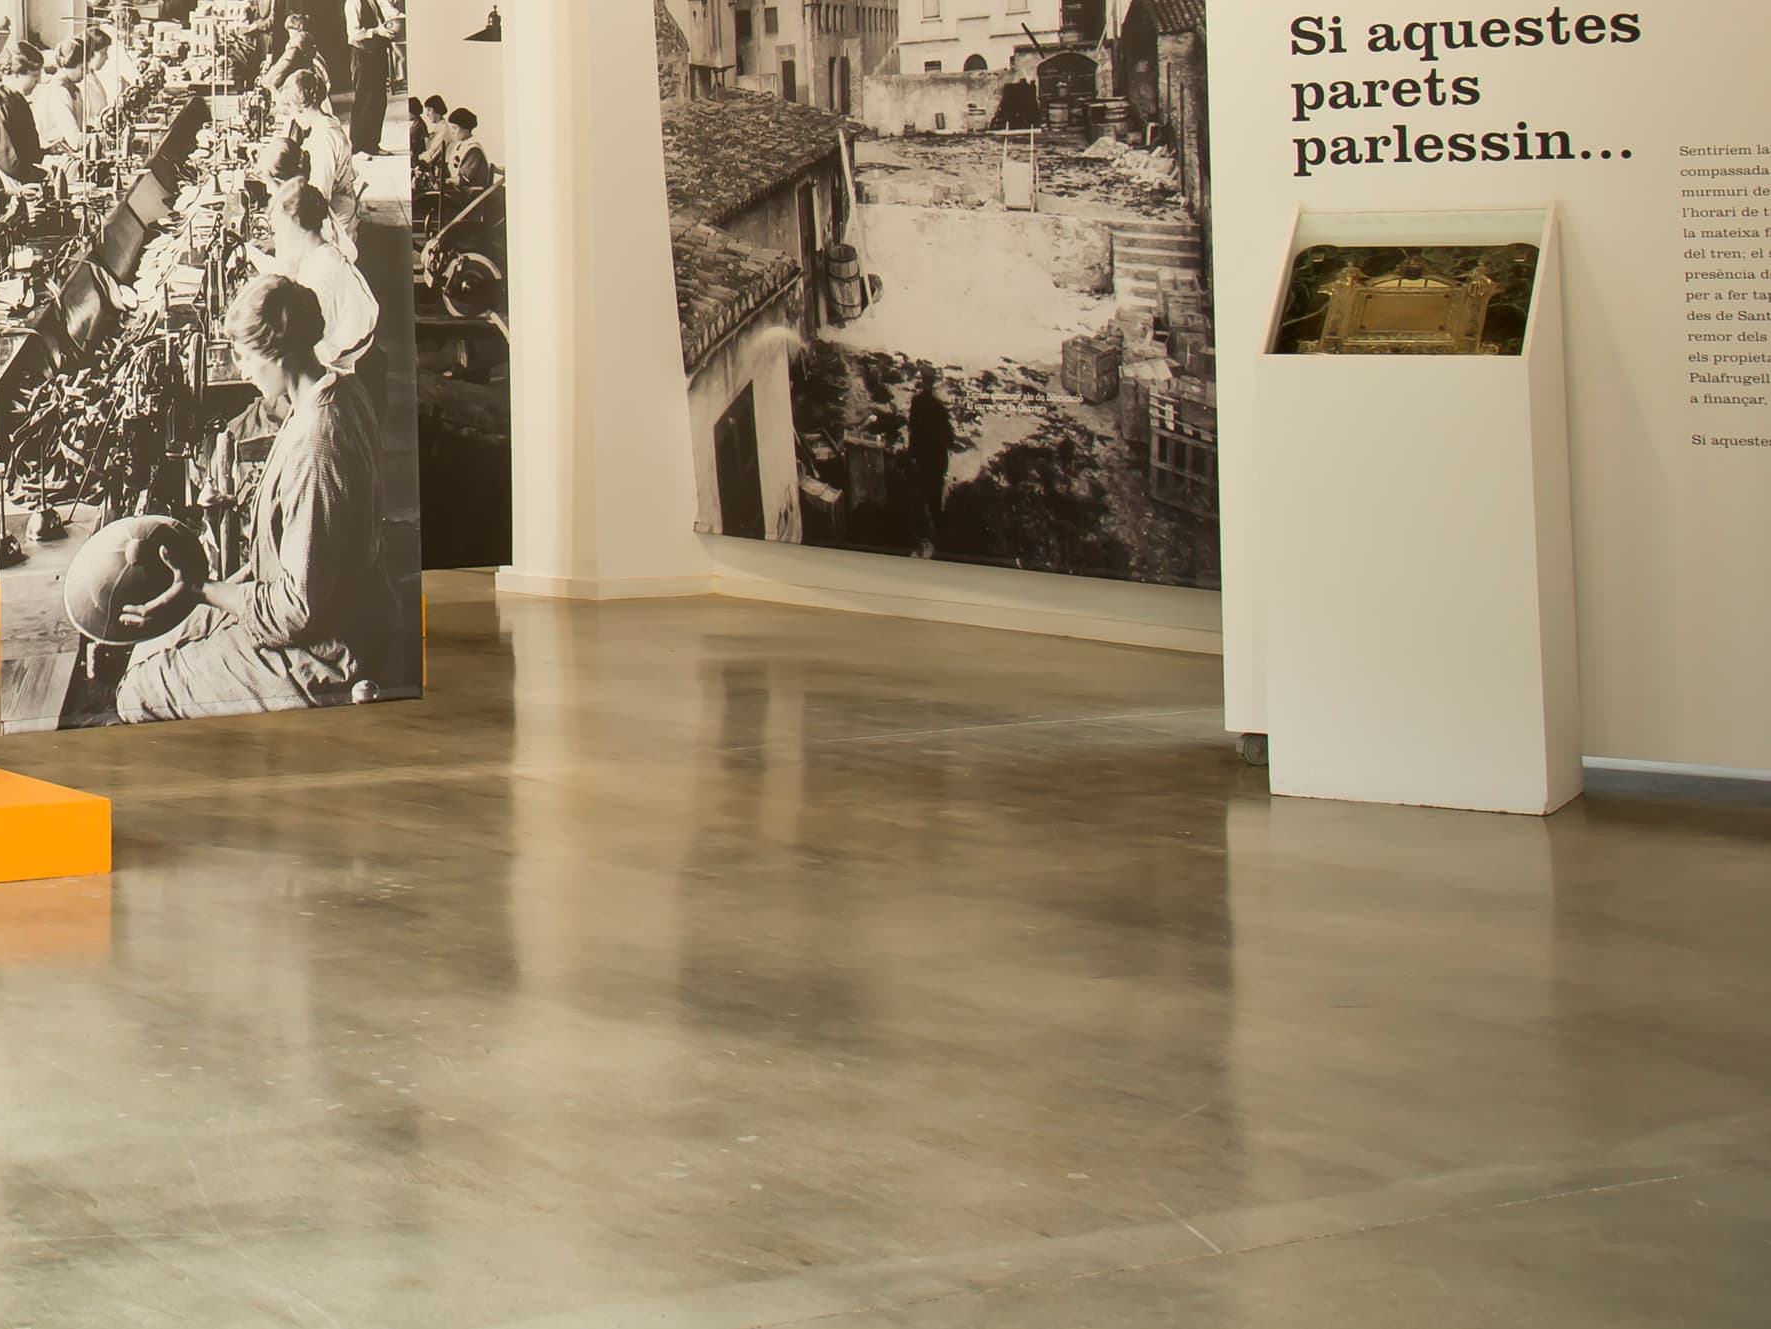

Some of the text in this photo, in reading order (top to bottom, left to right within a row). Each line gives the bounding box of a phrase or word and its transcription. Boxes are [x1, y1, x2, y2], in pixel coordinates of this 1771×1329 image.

[1291, 6, 1640, 61] Si aquestes
[1291, 68, 1480, 122] parets
[1293, 121, 1632, 177] parlessin...
[1757, 145, 1770, 154] la
[1680, 166, 1770, 179] compassada
[1682, 186, 1770, 197] murmuri de
[1741, 207, 1758, 216] de
[1684, 229, 1696, 238] la
[1701, 228, 1760, 238] mateixa
[1684, 249, 1705, 259] del
[1751, 248, 1763, 258] el
[1685, 269, 1756, 282] presència
[1686, 291, 1710, 302] per
[1715, 292, 1723, 300] a
[1728, 290, 1748, 300] fer
[1686, 311, 1771, 321] des de Sant
[1688, 331, 1767, 341] remor dels
[1688, 352, 1709, 362] els
[1690, 373, 1770, 386] Palafrugell
[1690, 395, 1699, 403] a
[1692, 435, 1706, 445] Si
